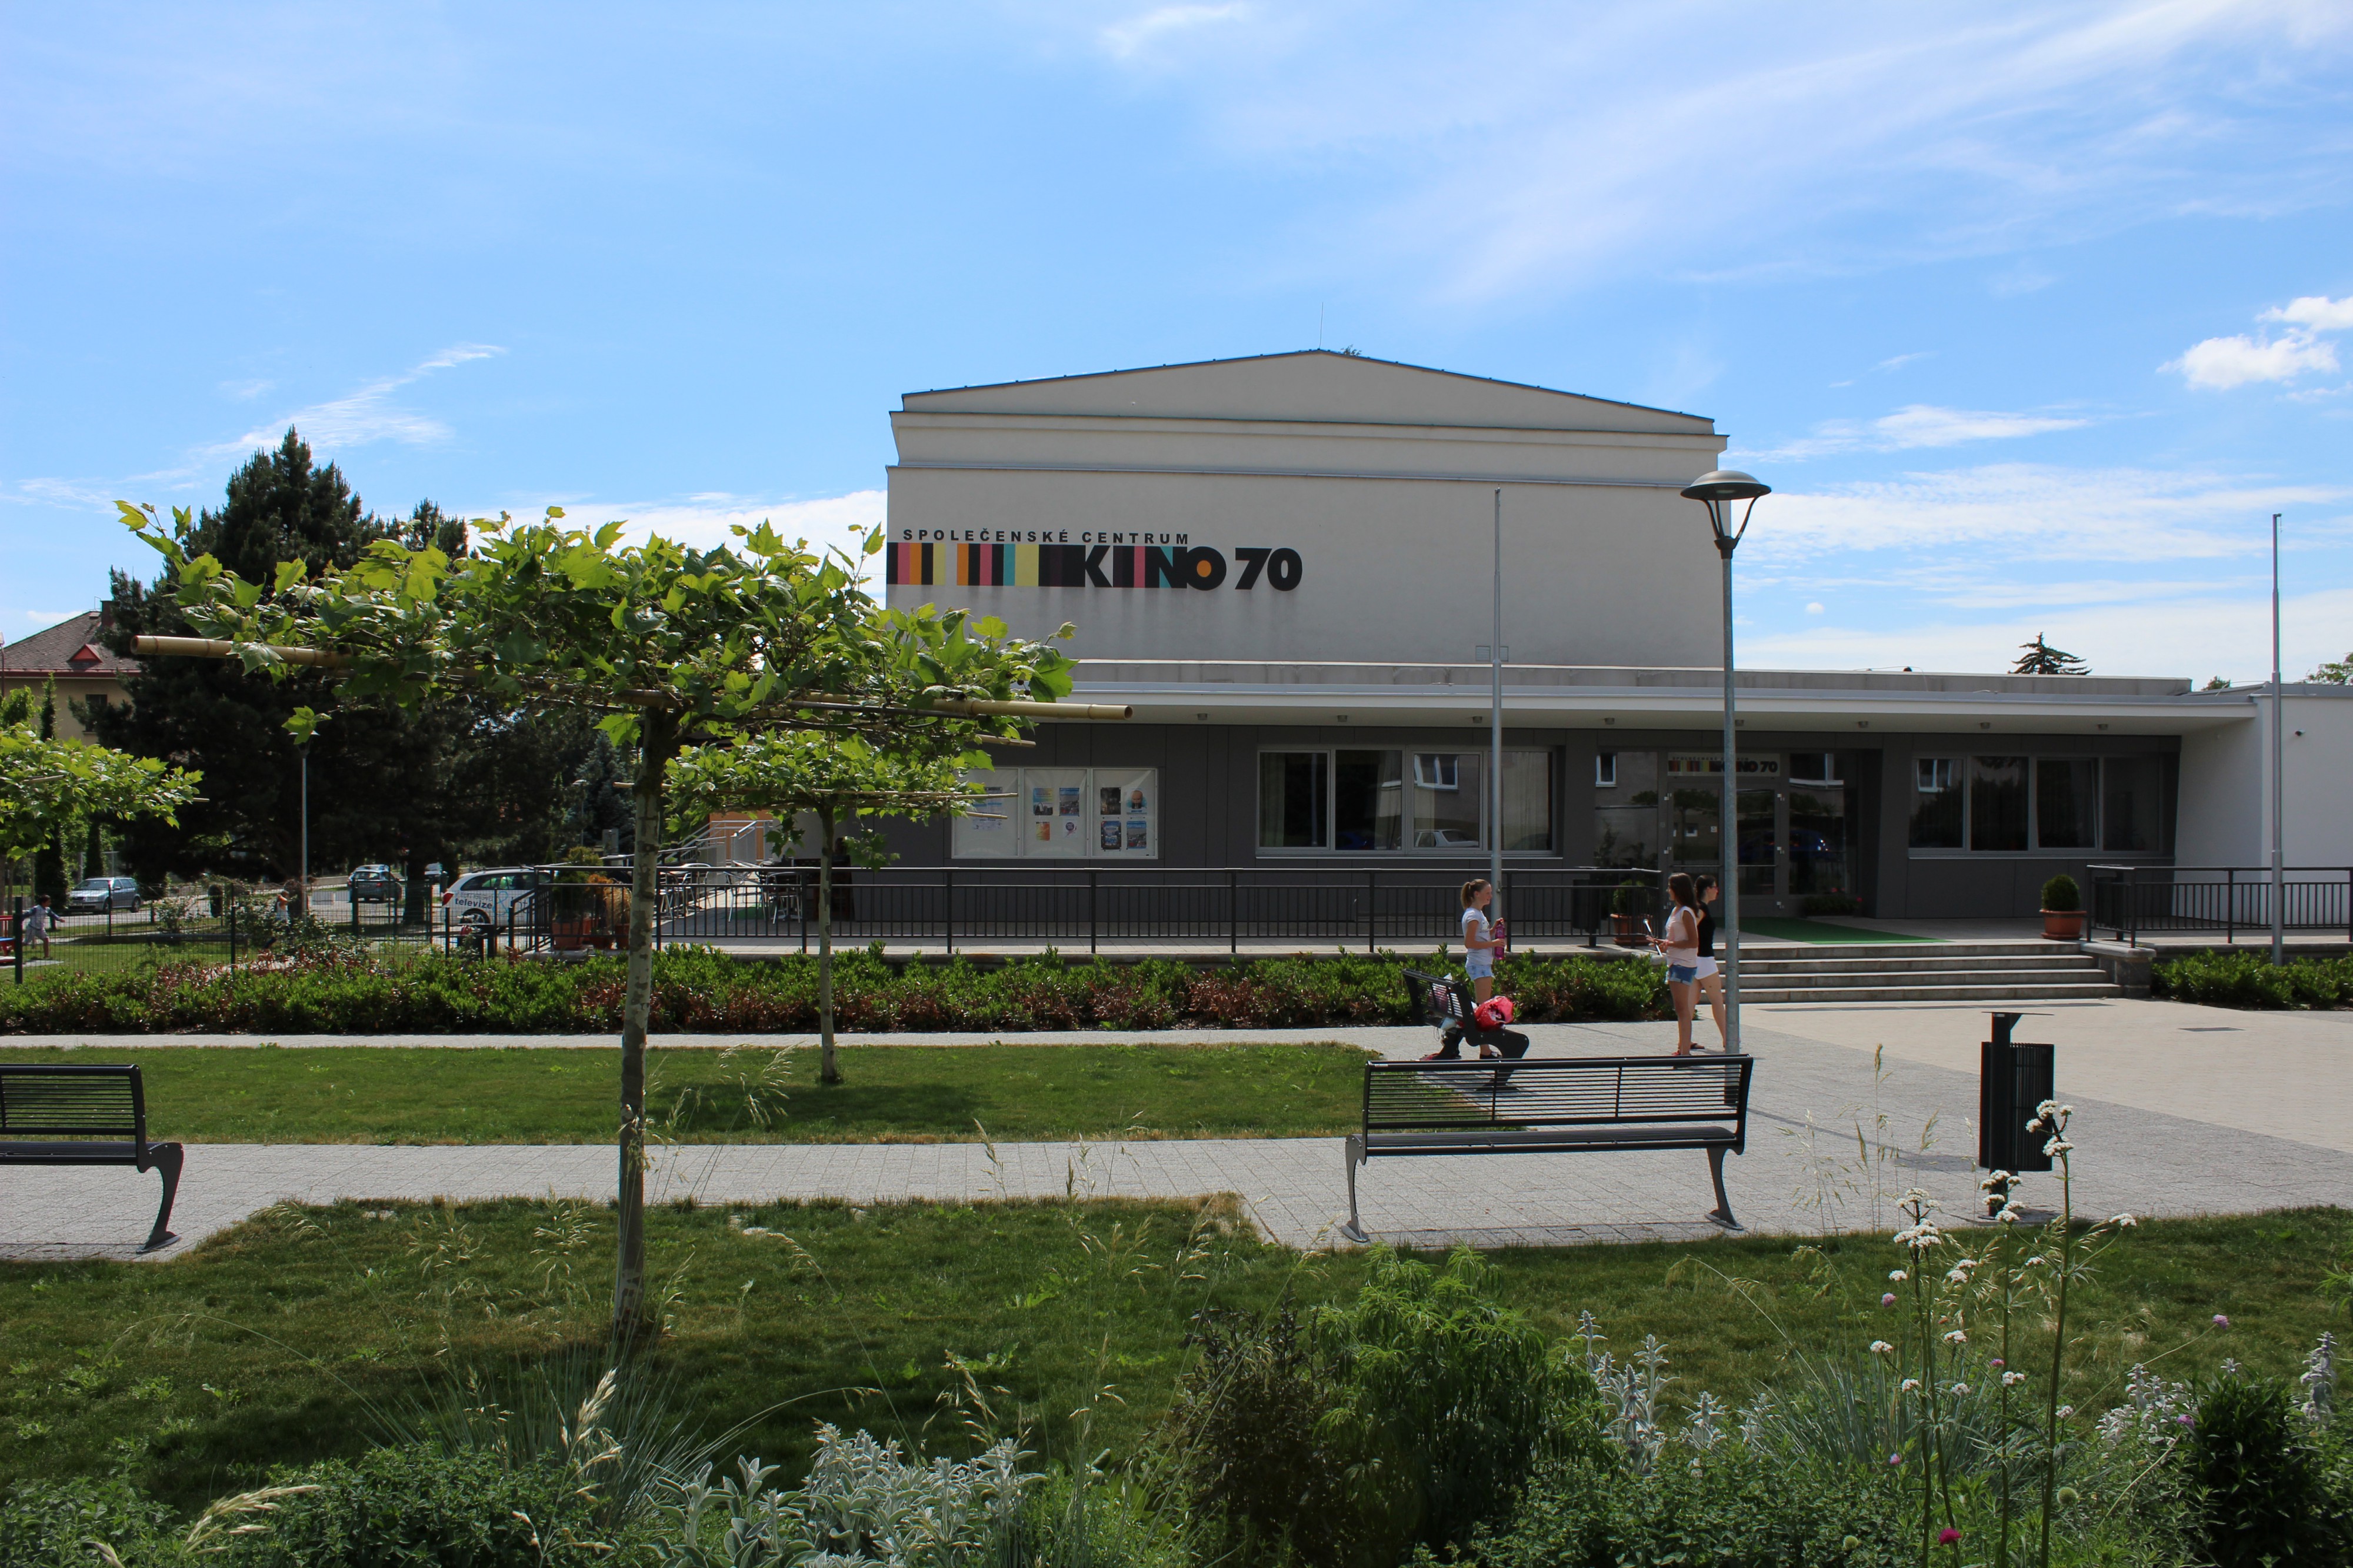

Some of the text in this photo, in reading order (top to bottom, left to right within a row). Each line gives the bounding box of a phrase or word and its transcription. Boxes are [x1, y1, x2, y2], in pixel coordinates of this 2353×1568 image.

[903, 528, 1189, 545] SPOLEČENSKÉ CENTRUM
[1062, 544, 1303, 592] KINO 70
[1760, 760, 1778, 773] 70
[455, 898, 493, 909] televize
